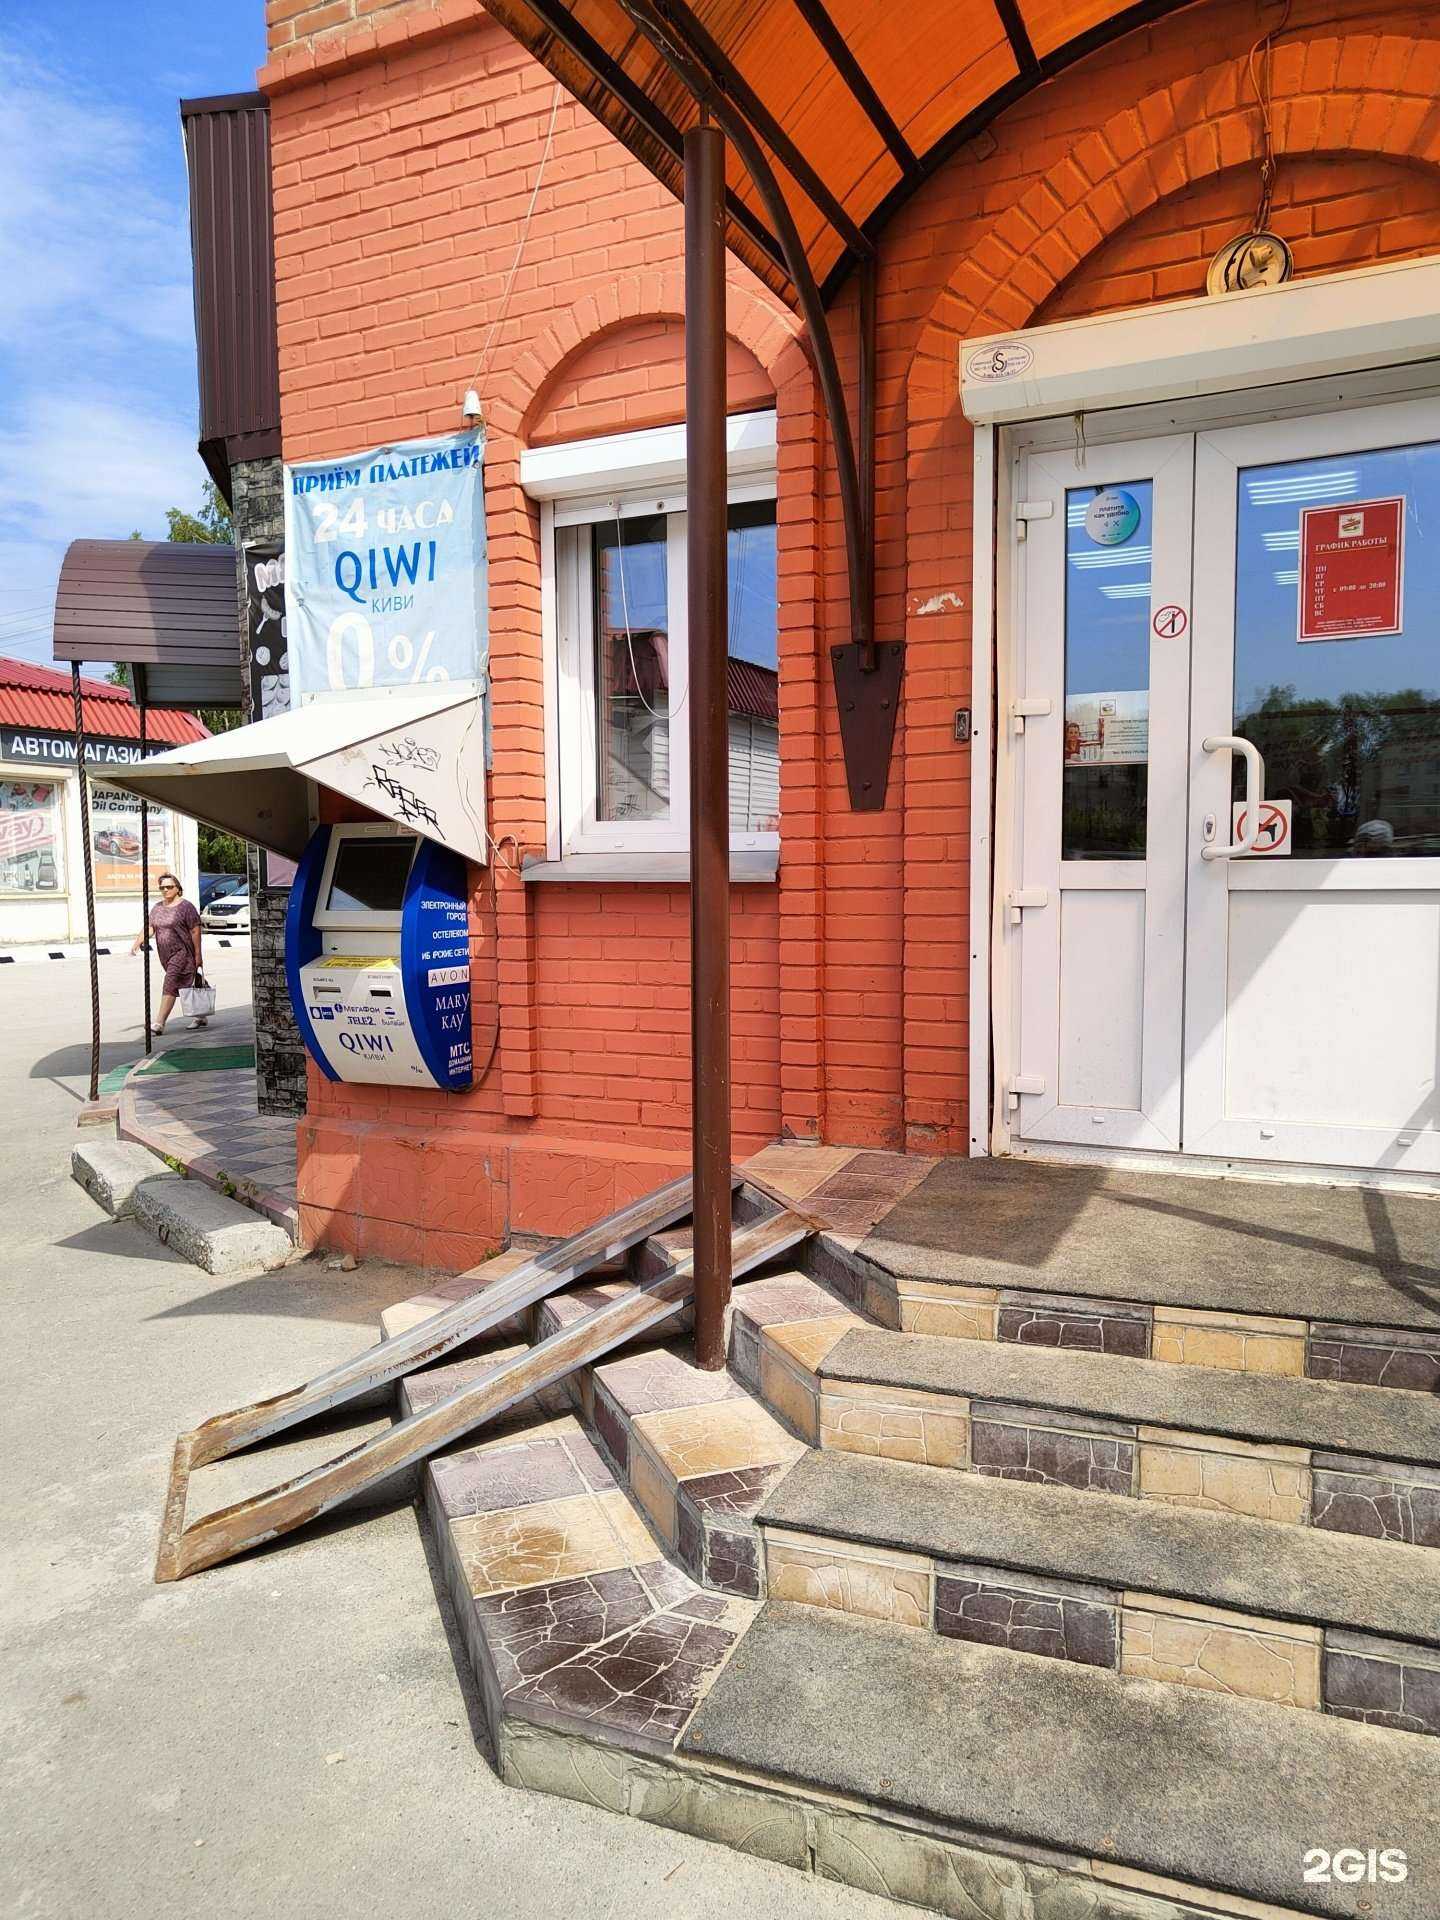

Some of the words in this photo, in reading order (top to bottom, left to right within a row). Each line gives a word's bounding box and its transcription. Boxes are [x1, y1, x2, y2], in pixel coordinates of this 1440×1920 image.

[292, 467, 361, 496] ПРИЁМ
[369, 444, 480, 484] ПЛАТЕЖЕЙ
[312, 497, 369, 544] 24
[376, 499, 454, 535] ЧАСА
[1314, 541, 1351, 552] ГРАФИК
[1351, 536, 1388, 548] РАБОТЫ
[334, 541, 437, 604] QIWI
[1315, 580, 1325, 588] СР
[371, 595, 414, 614] КИВИ
[1314, 609, 1325, 617] ВС
[92, 801, 107, 811] Oil
[420, 900, 467, 911] ЭЛЕКТРОННЫЙ
[446, 912, 467, 922] ГОРОД
[454, 947, 470, 957] СЕТИ
[430, 968, 469, 985] AVON
[435, 993, 470, 1011] MARY
[348, 1016, 376, 1026] TELE2
[441, 1013, 465, 1032] KAY
[339, 1032, 394, 1055] QIWI
[450, 1042, 470, 1058] МТС
